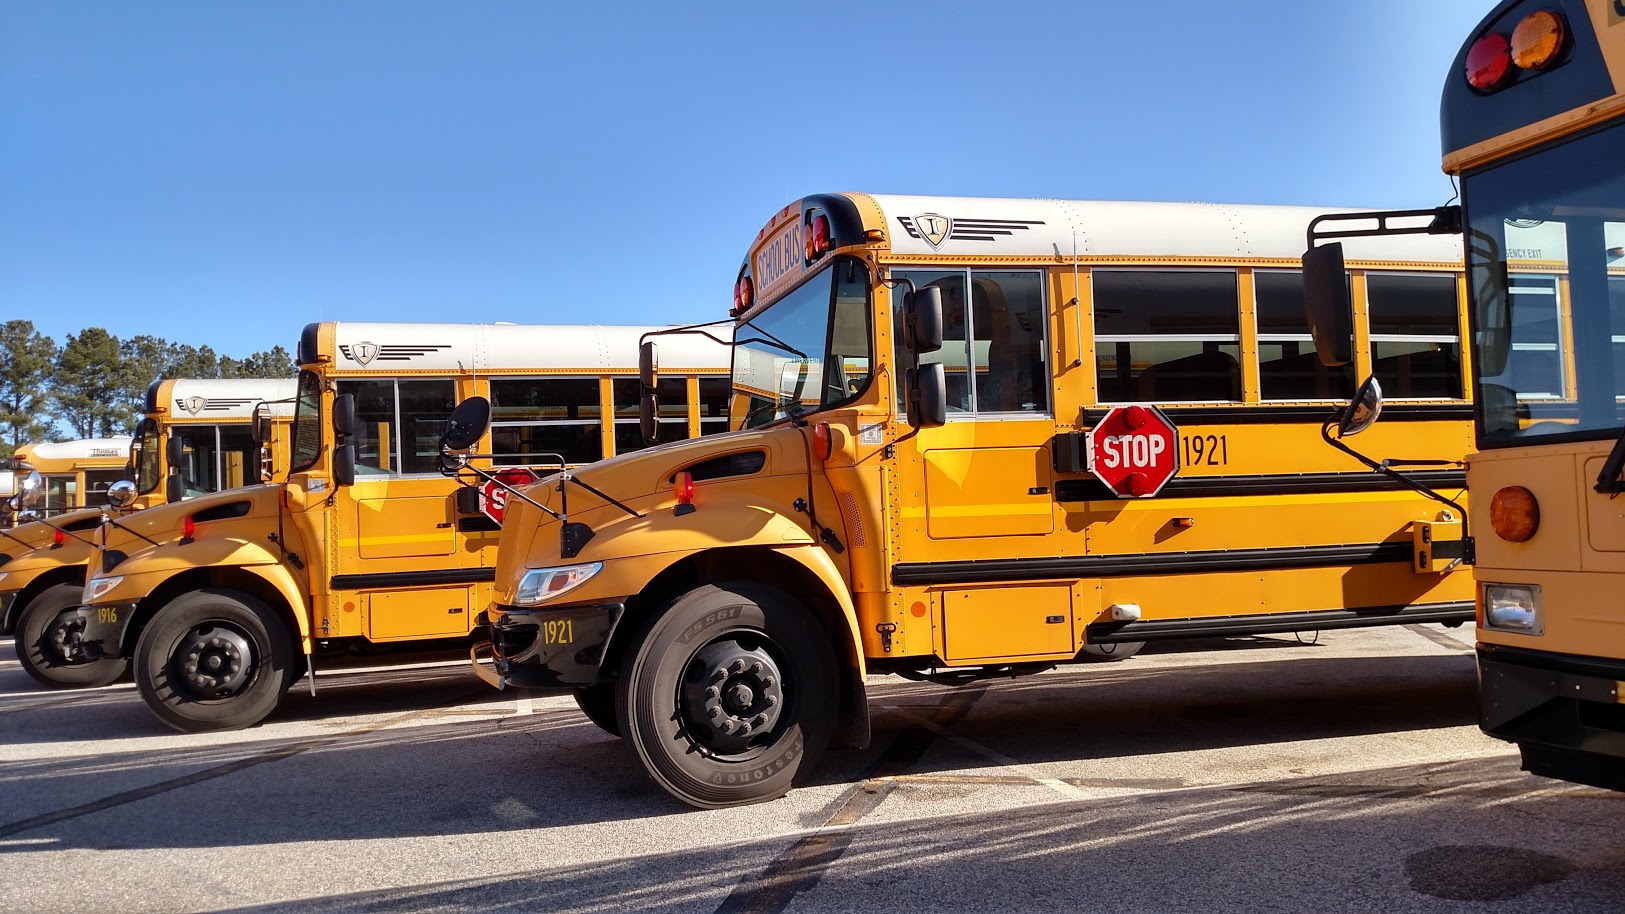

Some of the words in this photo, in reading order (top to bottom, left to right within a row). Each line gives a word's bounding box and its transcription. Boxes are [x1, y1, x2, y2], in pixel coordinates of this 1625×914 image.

[758, 238, 784, 291] SCHOOL
[784, 223, 800, 271] BUS
[1528, 249, 1542, 259] EXIT
[1103, 434, 1165, 468] STOP
[1183, 435, 1227, 466] 1921
[98, 607, 117, 624] 1916
[543, 620, 573, 644] 1921
